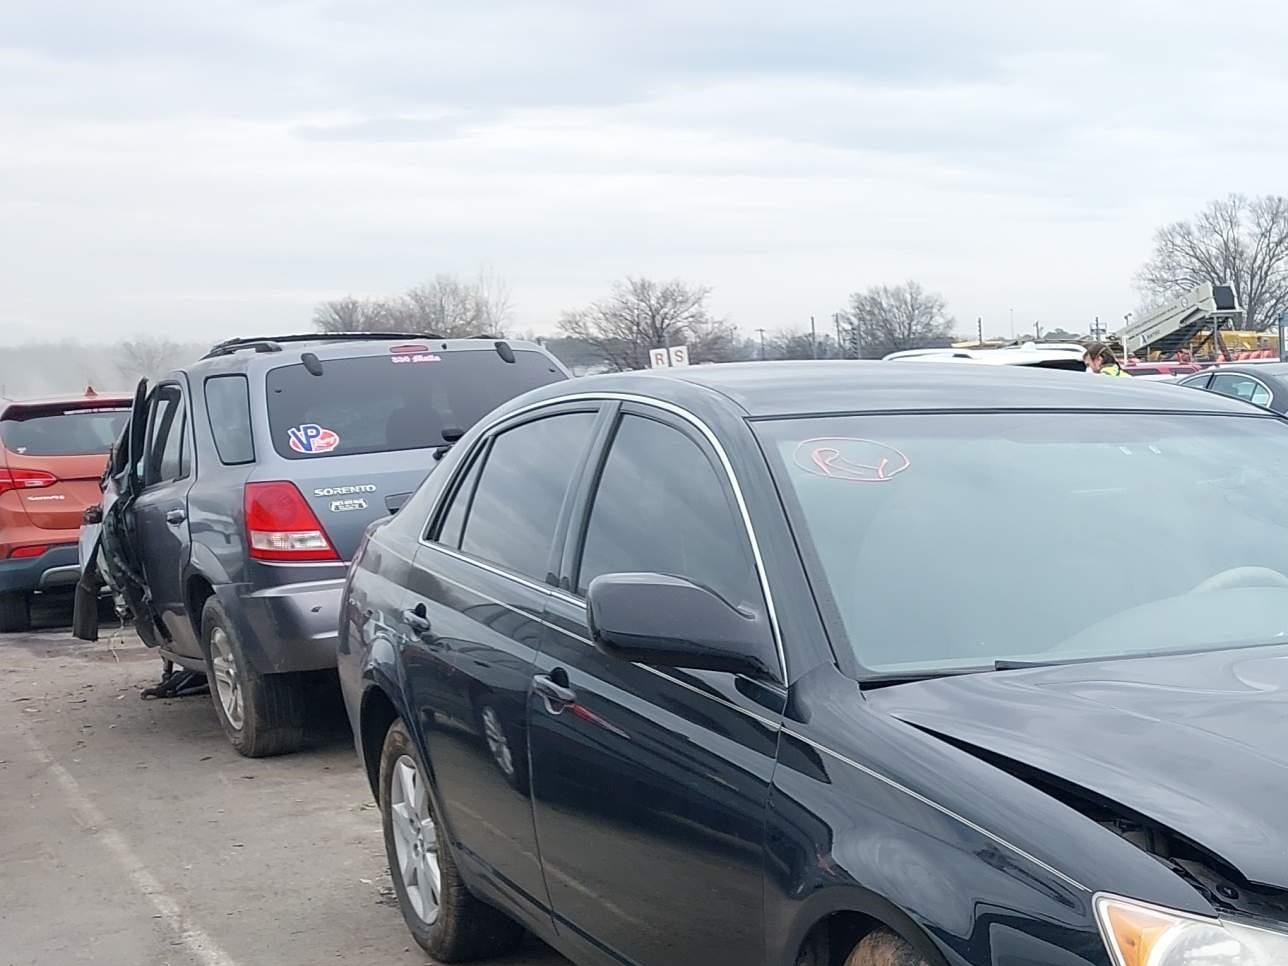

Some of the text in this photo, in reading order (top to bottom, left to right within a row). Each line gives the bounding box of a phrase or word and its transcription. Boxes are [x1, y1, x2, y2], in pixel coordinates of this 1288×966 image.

[655, 350, 683, 365] R S
[288, 424, 321, 452] VP
[314, 484, 377, 497] SORENTO
